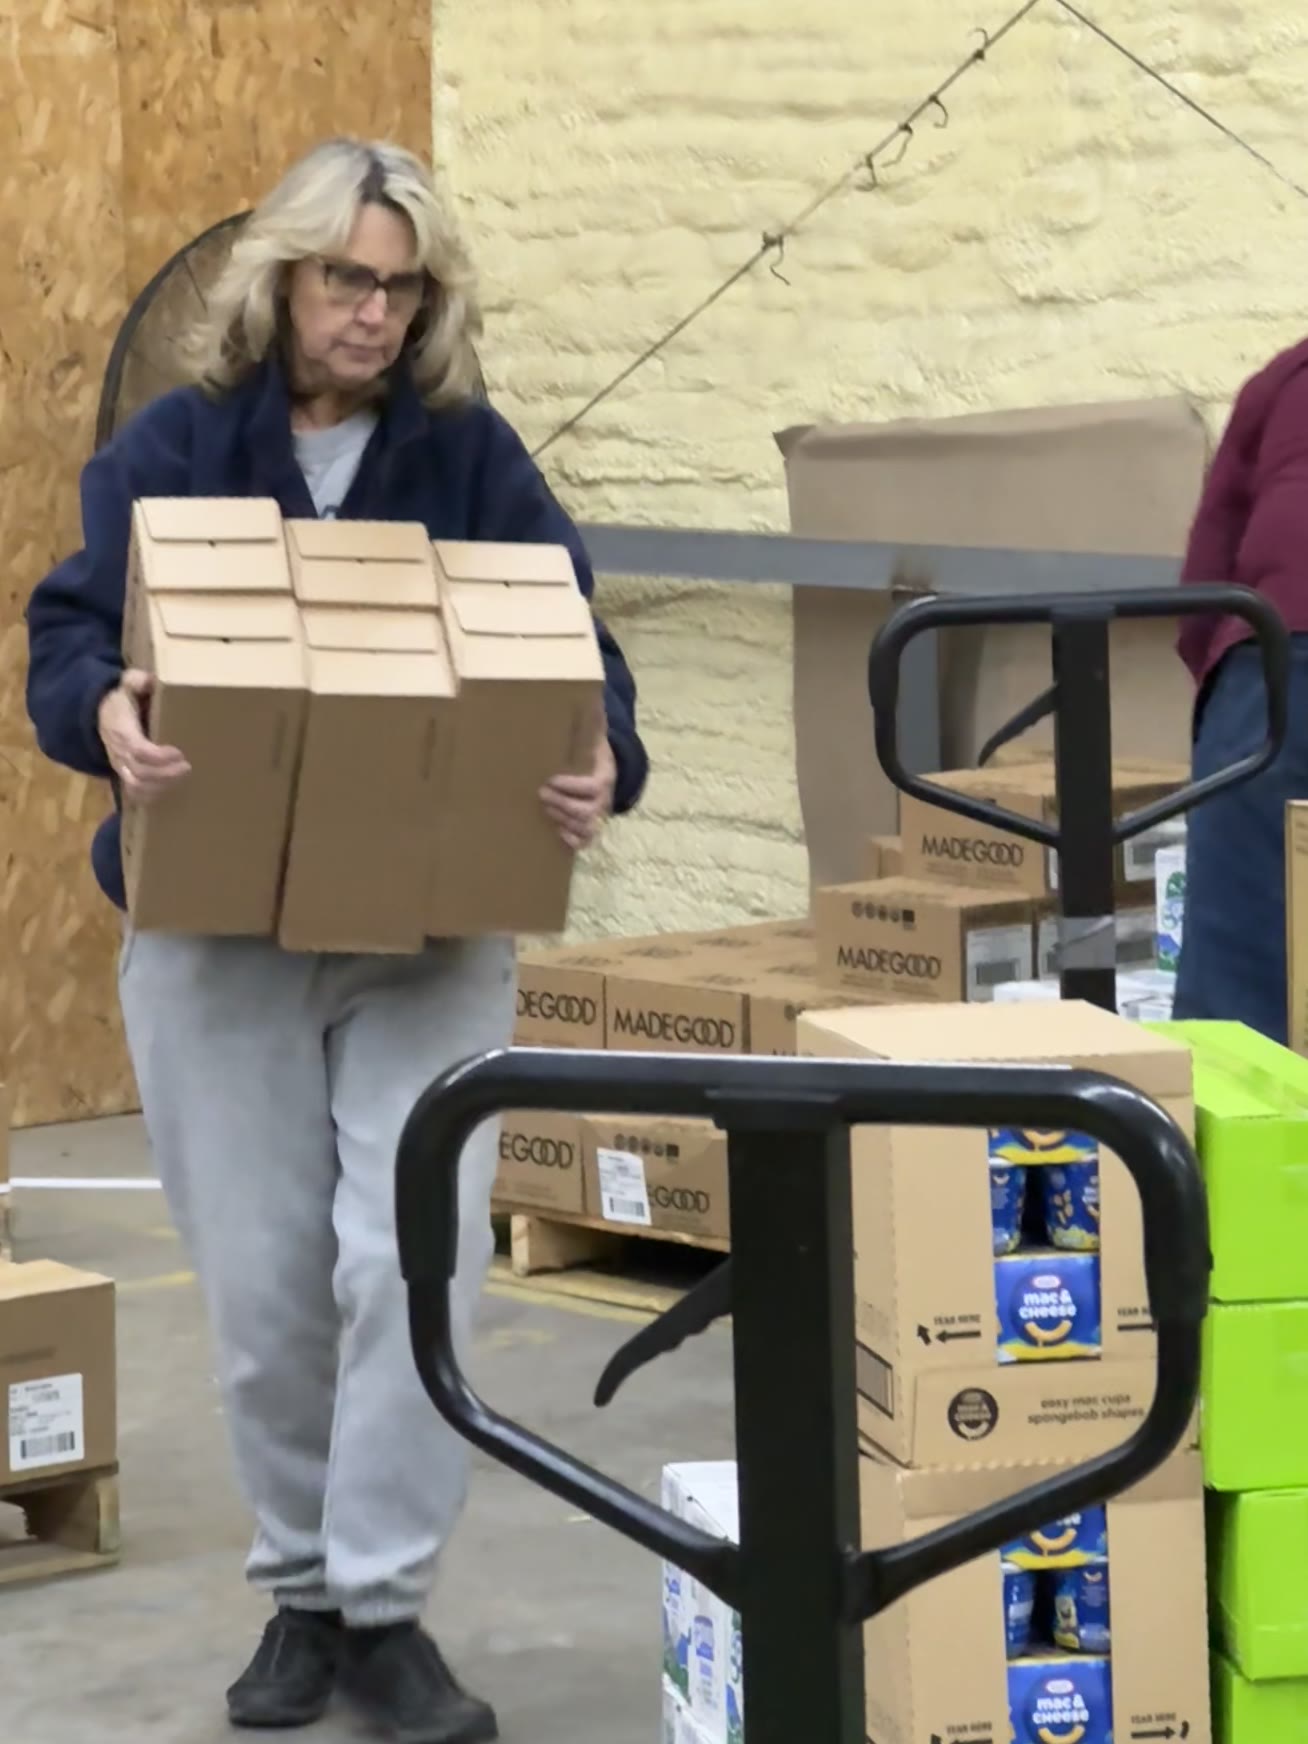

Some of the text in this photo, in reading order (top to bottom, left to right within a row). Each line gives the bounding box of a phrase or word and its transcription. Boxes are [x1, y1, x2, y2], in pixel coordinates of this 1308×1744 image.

[921, 834, 1024, 867] MADEGOOD
[837, 945, 942, 980] MADEGOOD
[516, 989, 597, 1026] DEGOOD
[613, 1008, 735, 1048] MADEGOOD
[500, 1131, 574, 1169] EGOOD
